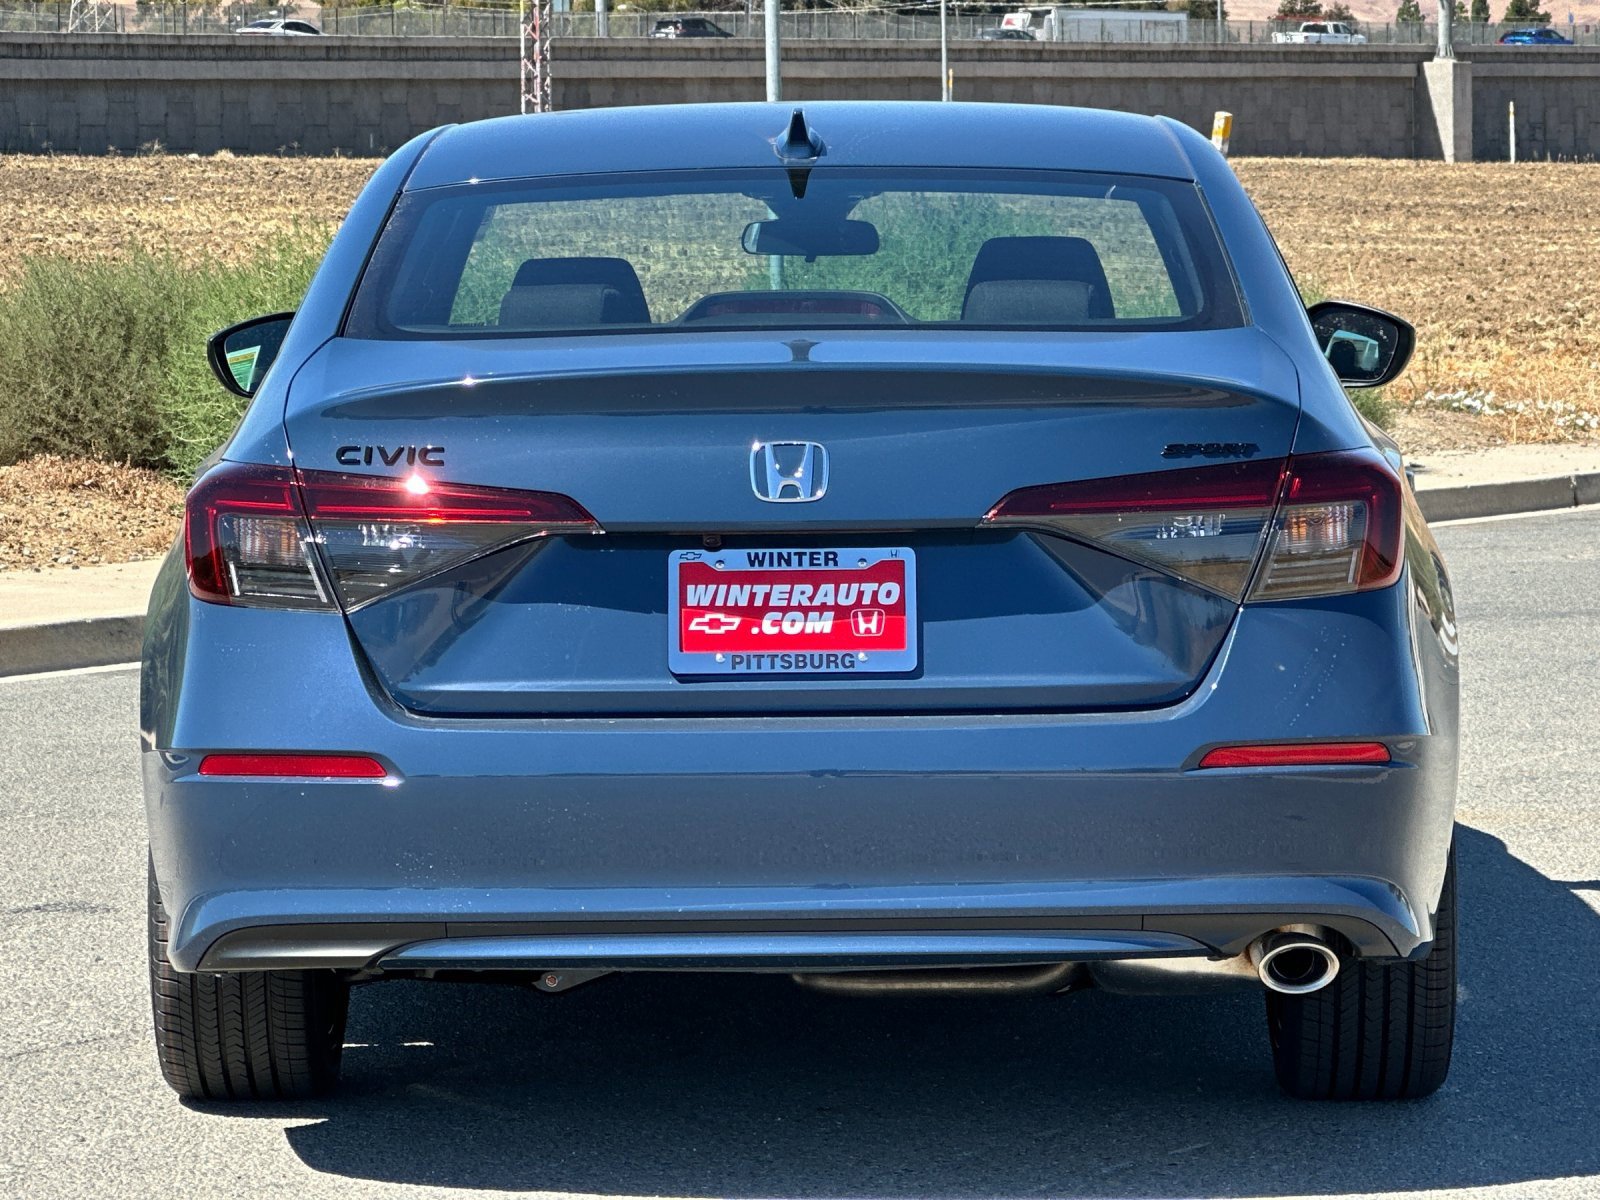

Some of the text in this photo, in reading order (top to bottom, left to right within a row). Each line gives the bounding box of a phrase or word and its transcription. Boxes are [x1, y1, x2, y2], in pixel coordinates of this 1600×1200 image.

[336, 445, 445, 466] CIVIC
[747, 551, 838, 567] WINTER
[686, 582, 900, 606] WINTERAUTO
[751, 612, 834, 635] .COM
[731, 653, 855, 670] PITTSBURG
